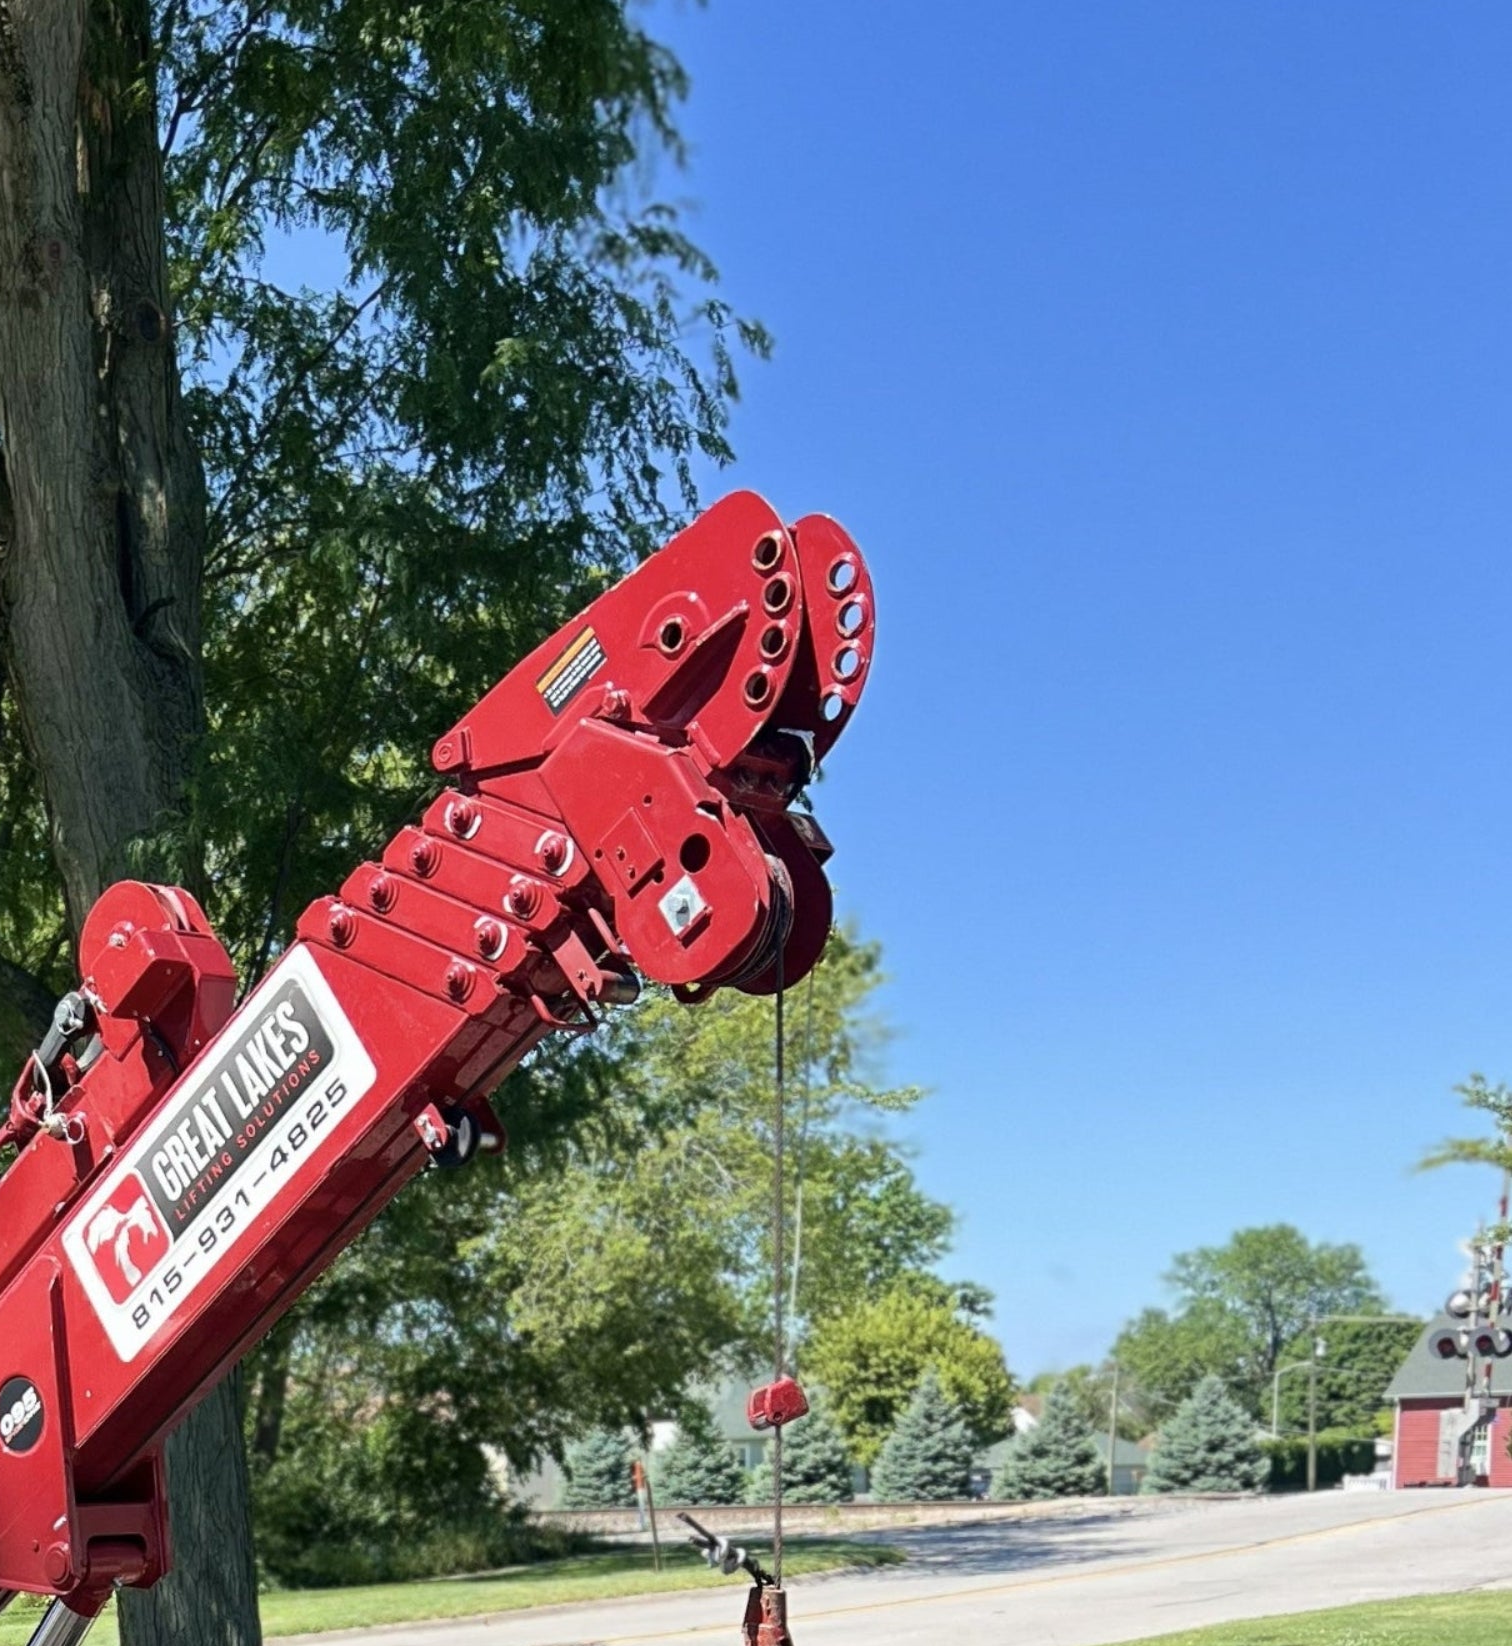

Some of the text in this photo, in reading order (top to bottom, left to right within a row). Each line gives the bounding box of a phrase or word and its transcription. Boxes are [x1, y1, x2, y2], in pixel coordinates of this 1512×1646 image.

[151, 1000, 310, 1202] GREAT LAKES
[174, 1049, 321, 1220] LIFTING SOLUTIONS
[132, 1077, 348, 1330] 815-931-4825
